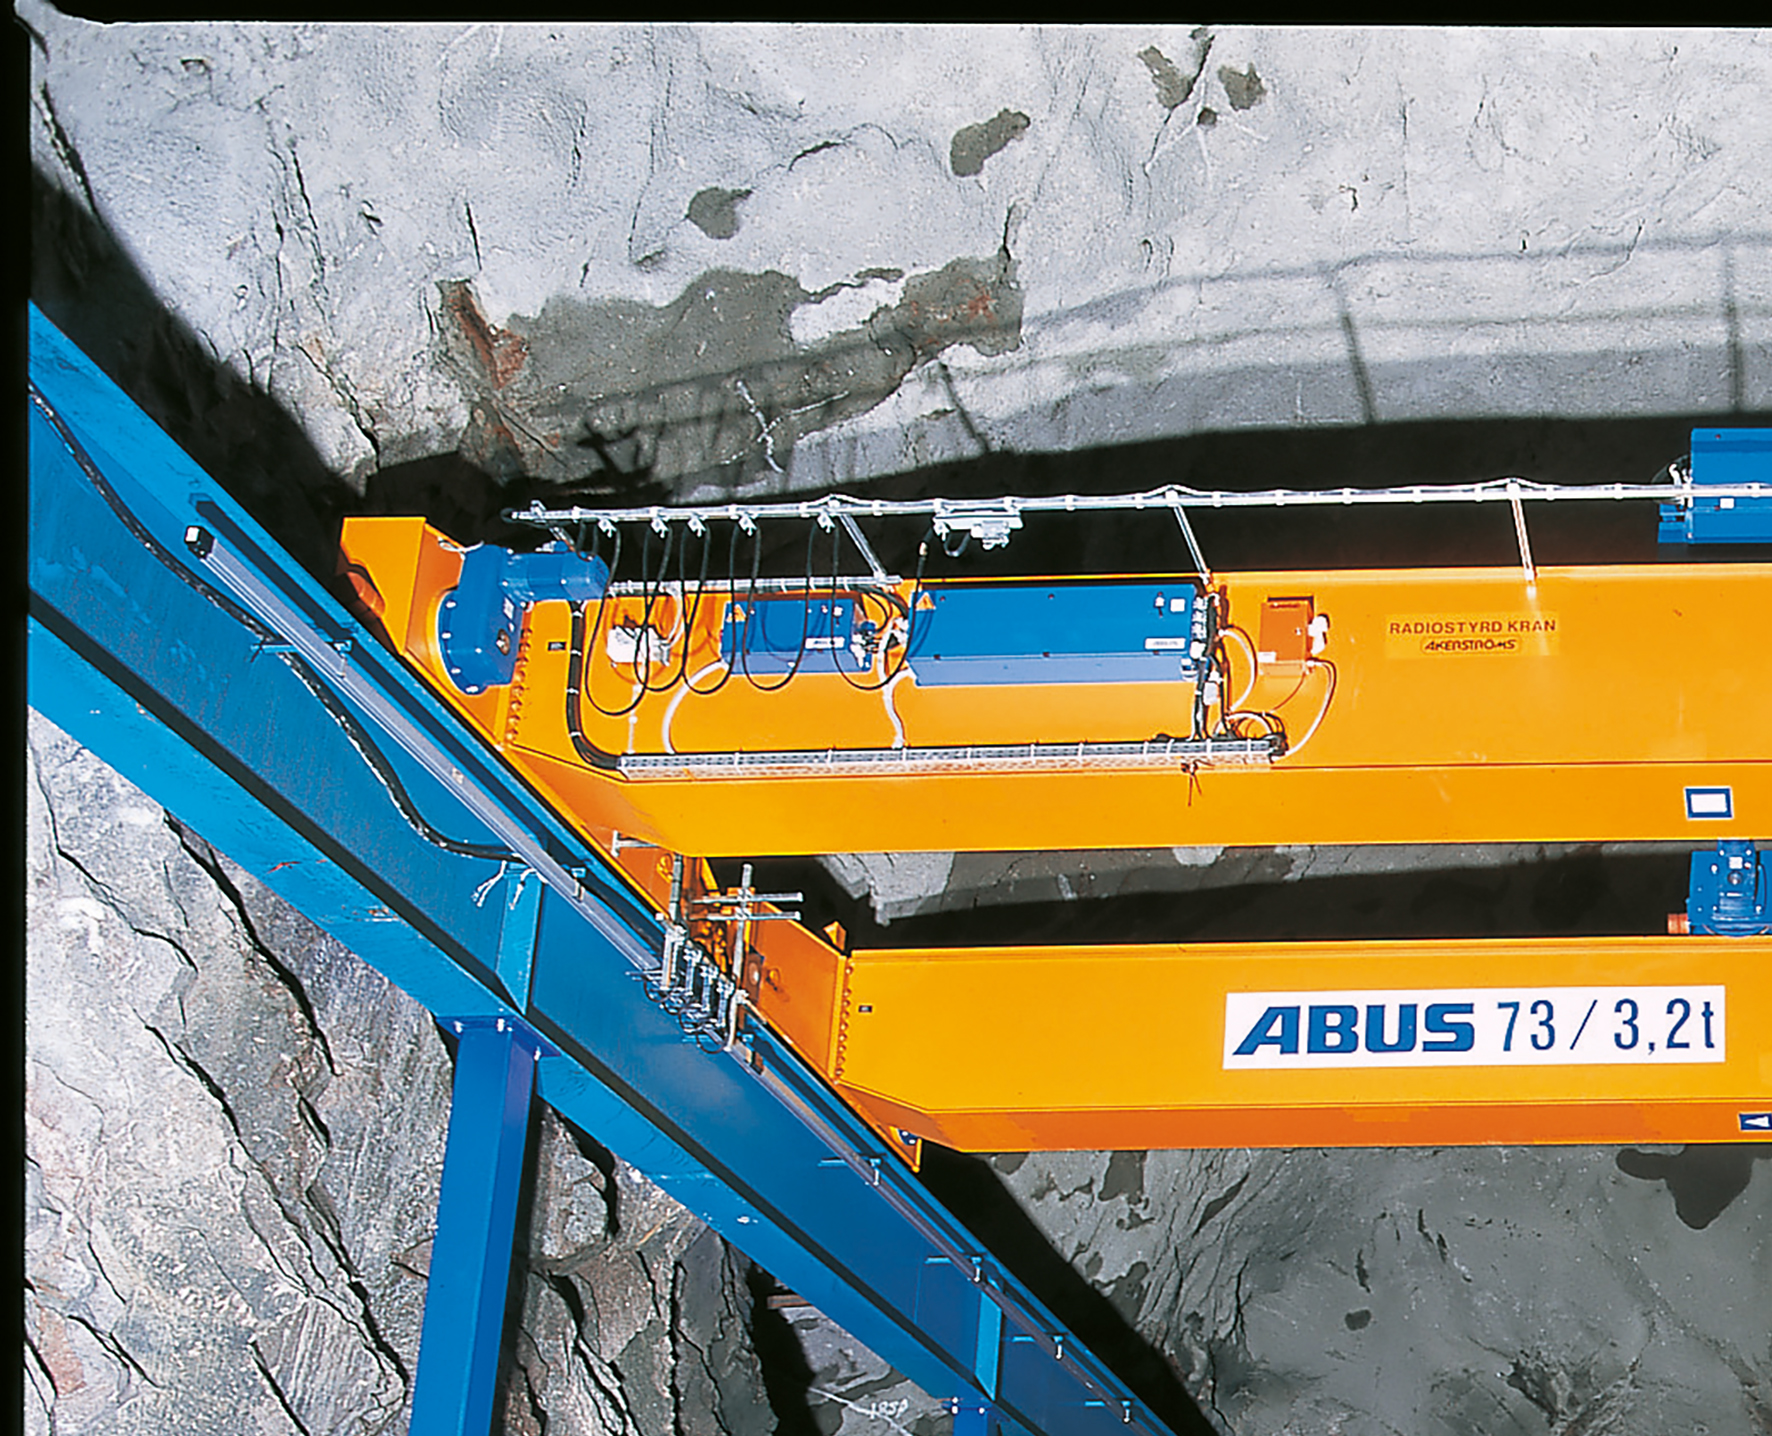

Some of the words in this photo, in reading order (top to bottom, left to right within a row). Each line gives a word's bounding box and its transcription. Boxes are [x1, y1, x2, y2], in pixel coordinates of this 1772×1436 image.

[1389, 620, 1503, 635] RADIOSTYRD
[1507, 619, 1556, 633] KRAN
[1232, 1002, 1475, 1056] ABUS
